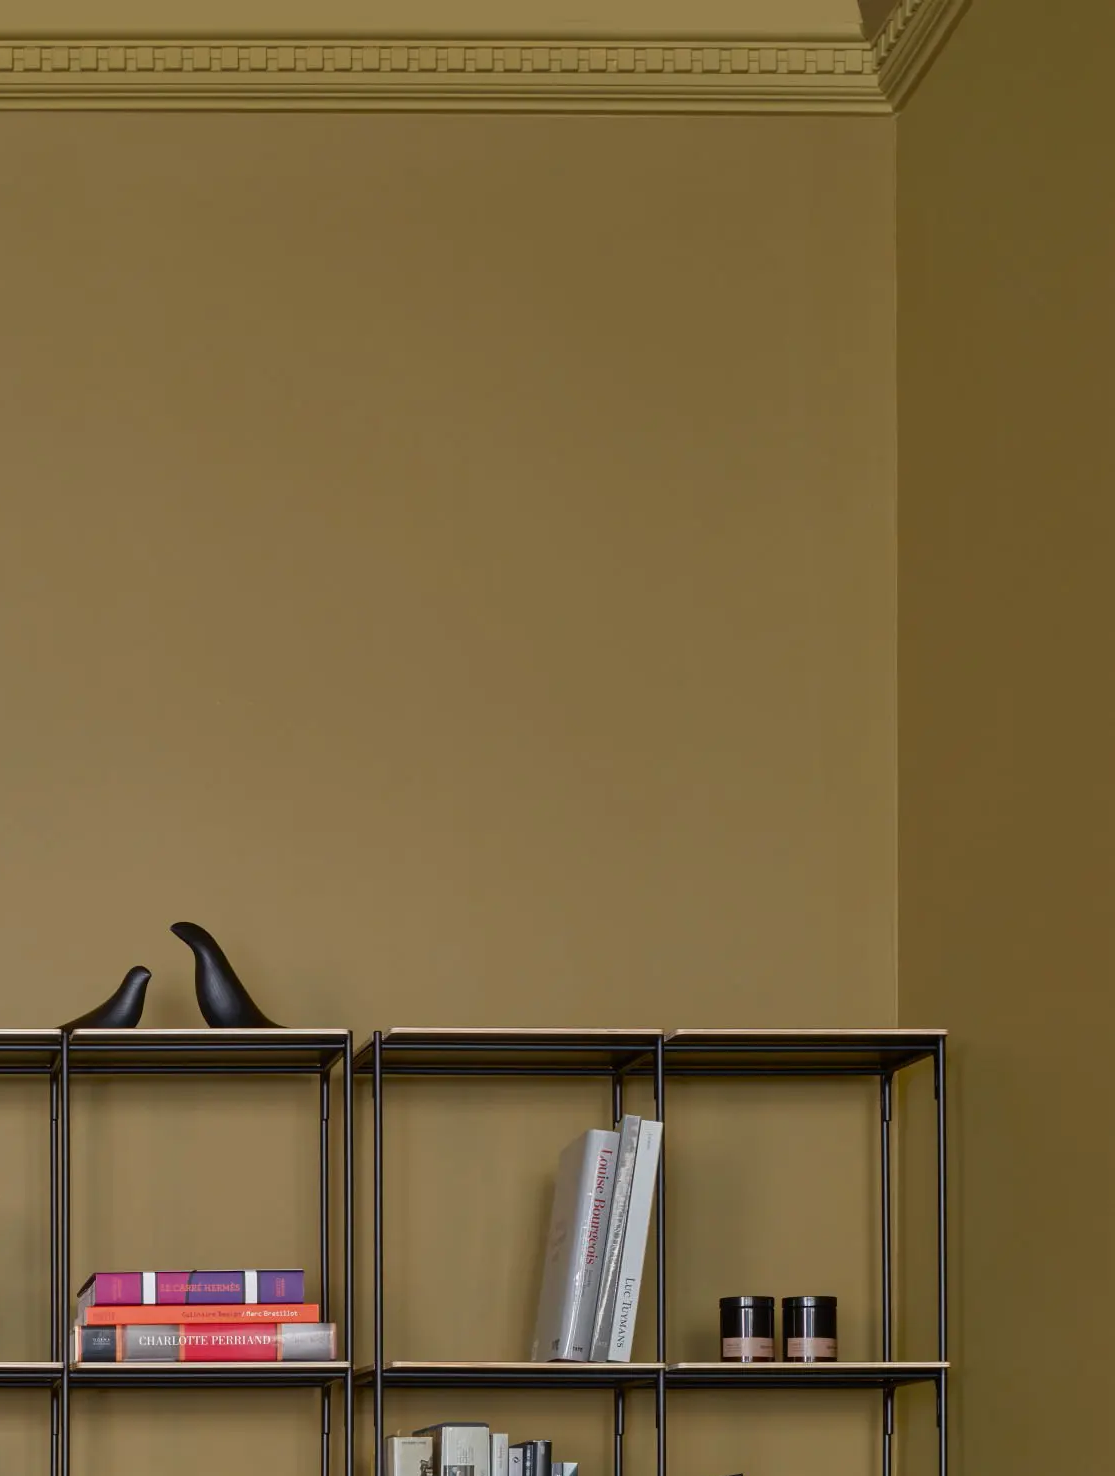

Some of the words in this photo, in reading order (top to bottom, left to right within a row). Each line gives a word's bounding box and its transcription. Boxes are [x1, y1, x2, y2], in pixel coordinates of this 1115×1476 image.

[596, 1149, 613, 1193] Louise
[585, 1198, 606, 1265] Bourgeois
[203, 1282, 241, 1292] HERMÈS
[139, 1335, 209, 1346] CHARLOTTE
[211, 1335, 270, 1346] PERRIAND
